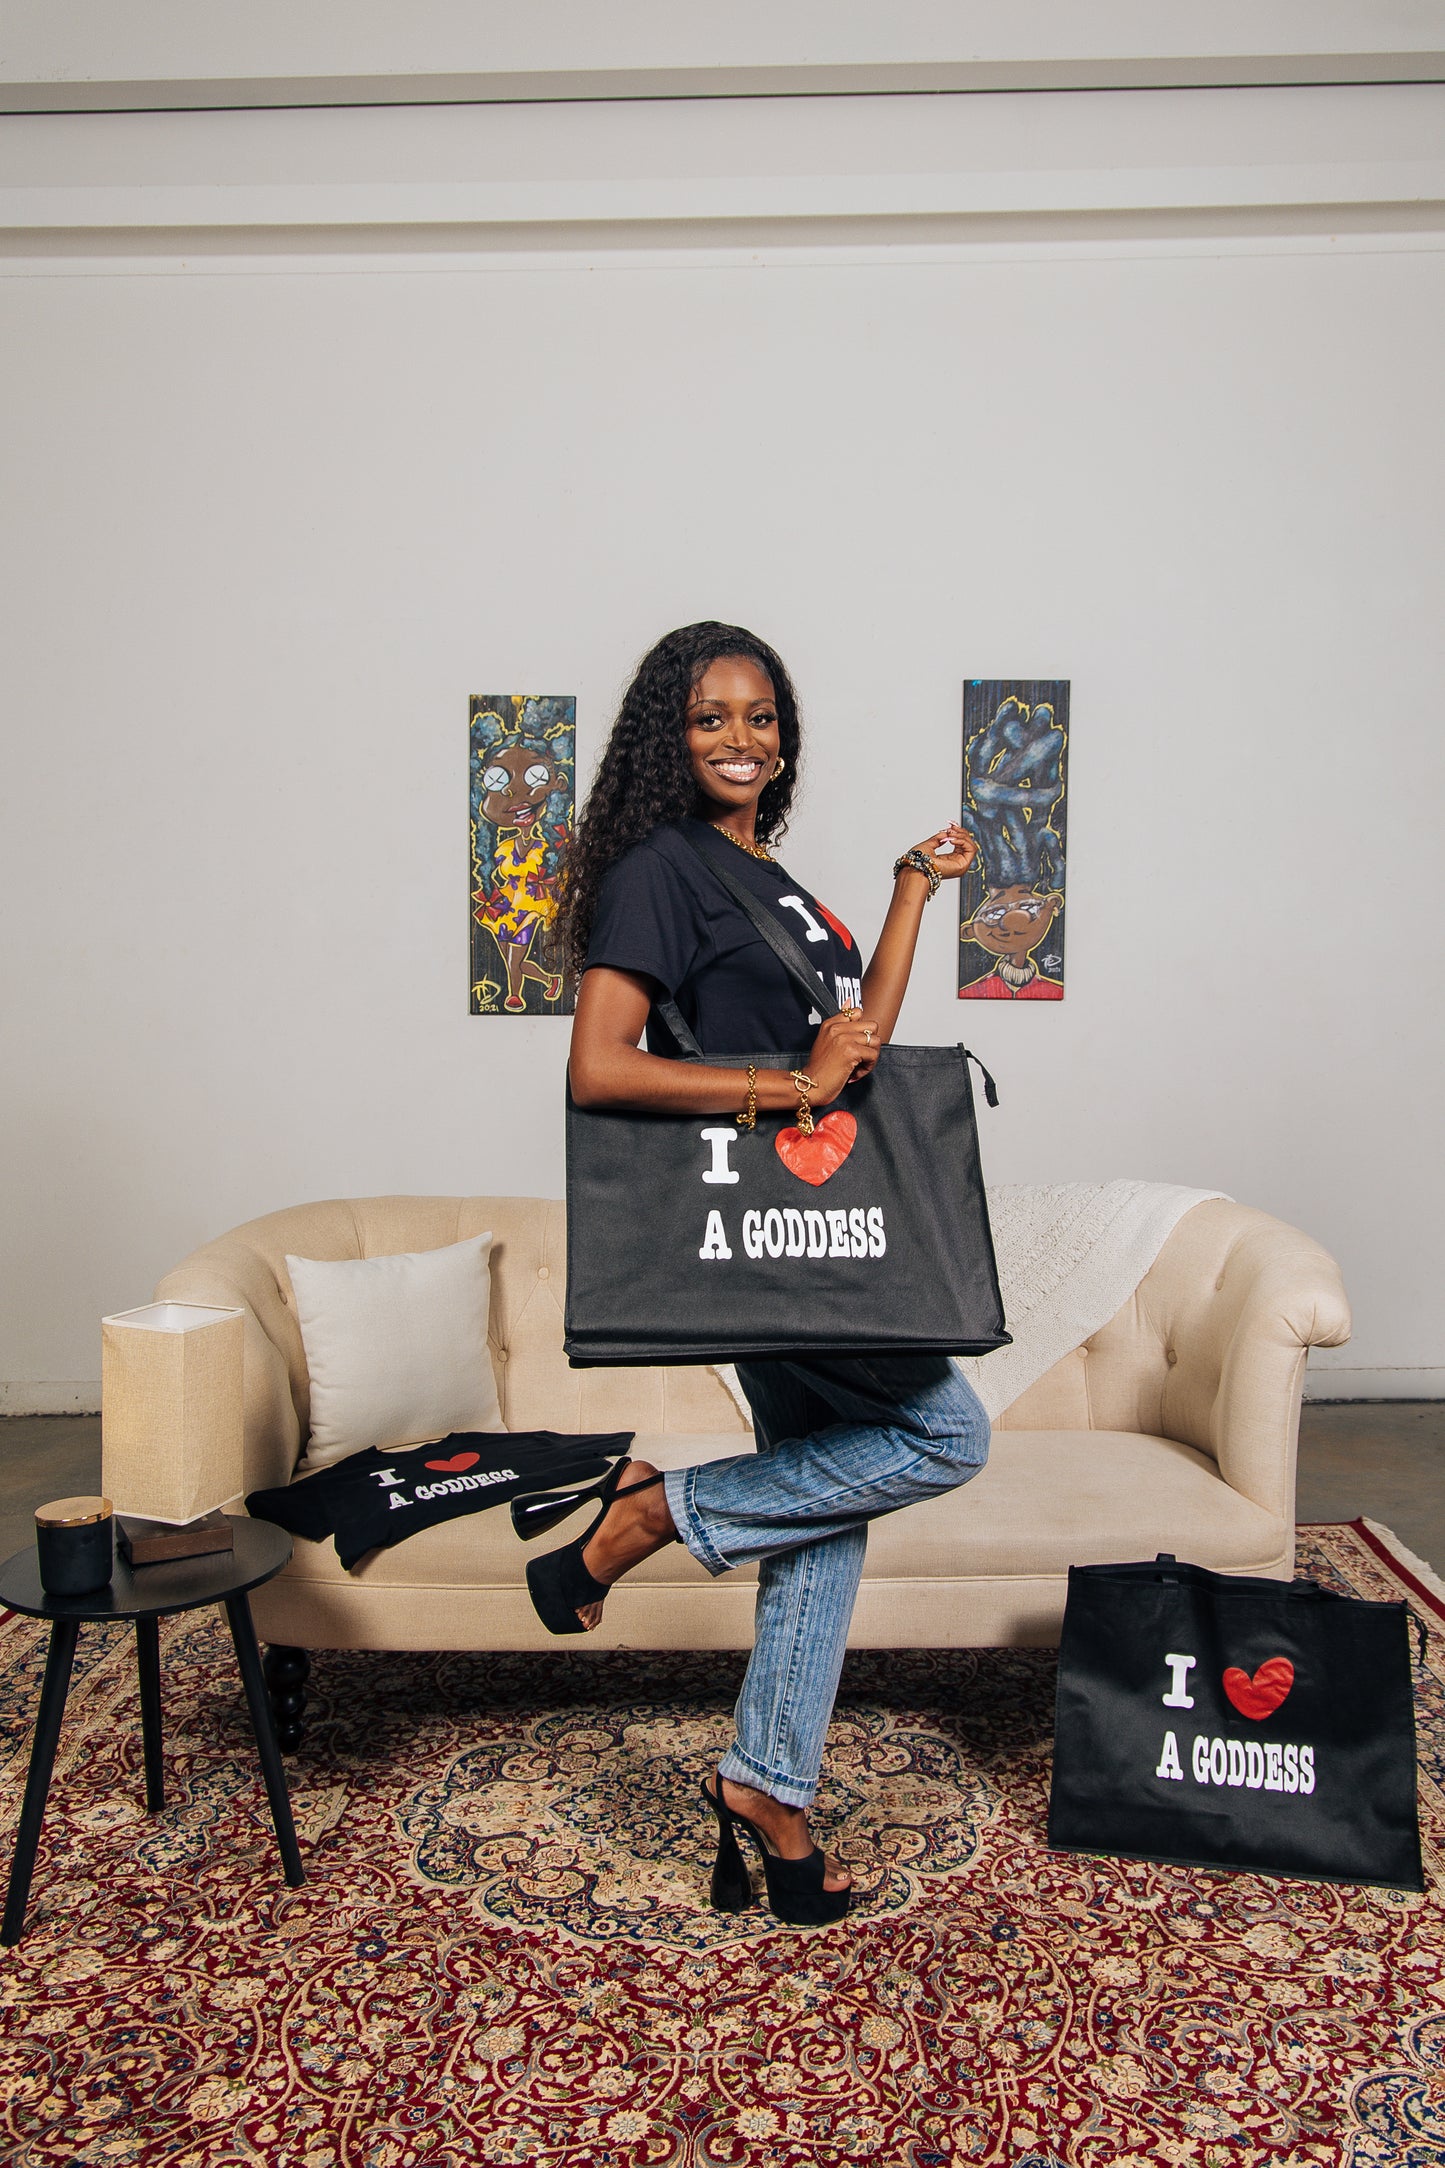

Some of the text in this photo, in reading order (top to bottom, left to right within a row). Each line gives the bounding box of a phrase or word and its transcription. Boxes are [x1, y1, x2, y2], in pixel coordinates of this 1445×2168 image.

[778, 895, 829, 943] I
[700, 1127, 740, 1184] I
[698, 1206, 887, 1260] A GODDESS
[369, 1468, 406, 1487] I
[389, 1468, 520, 1510] A GODDESS
[1162, 1653, 1197, 1709] I
[1155, 1730, 1316, 1795] A GODDESS
